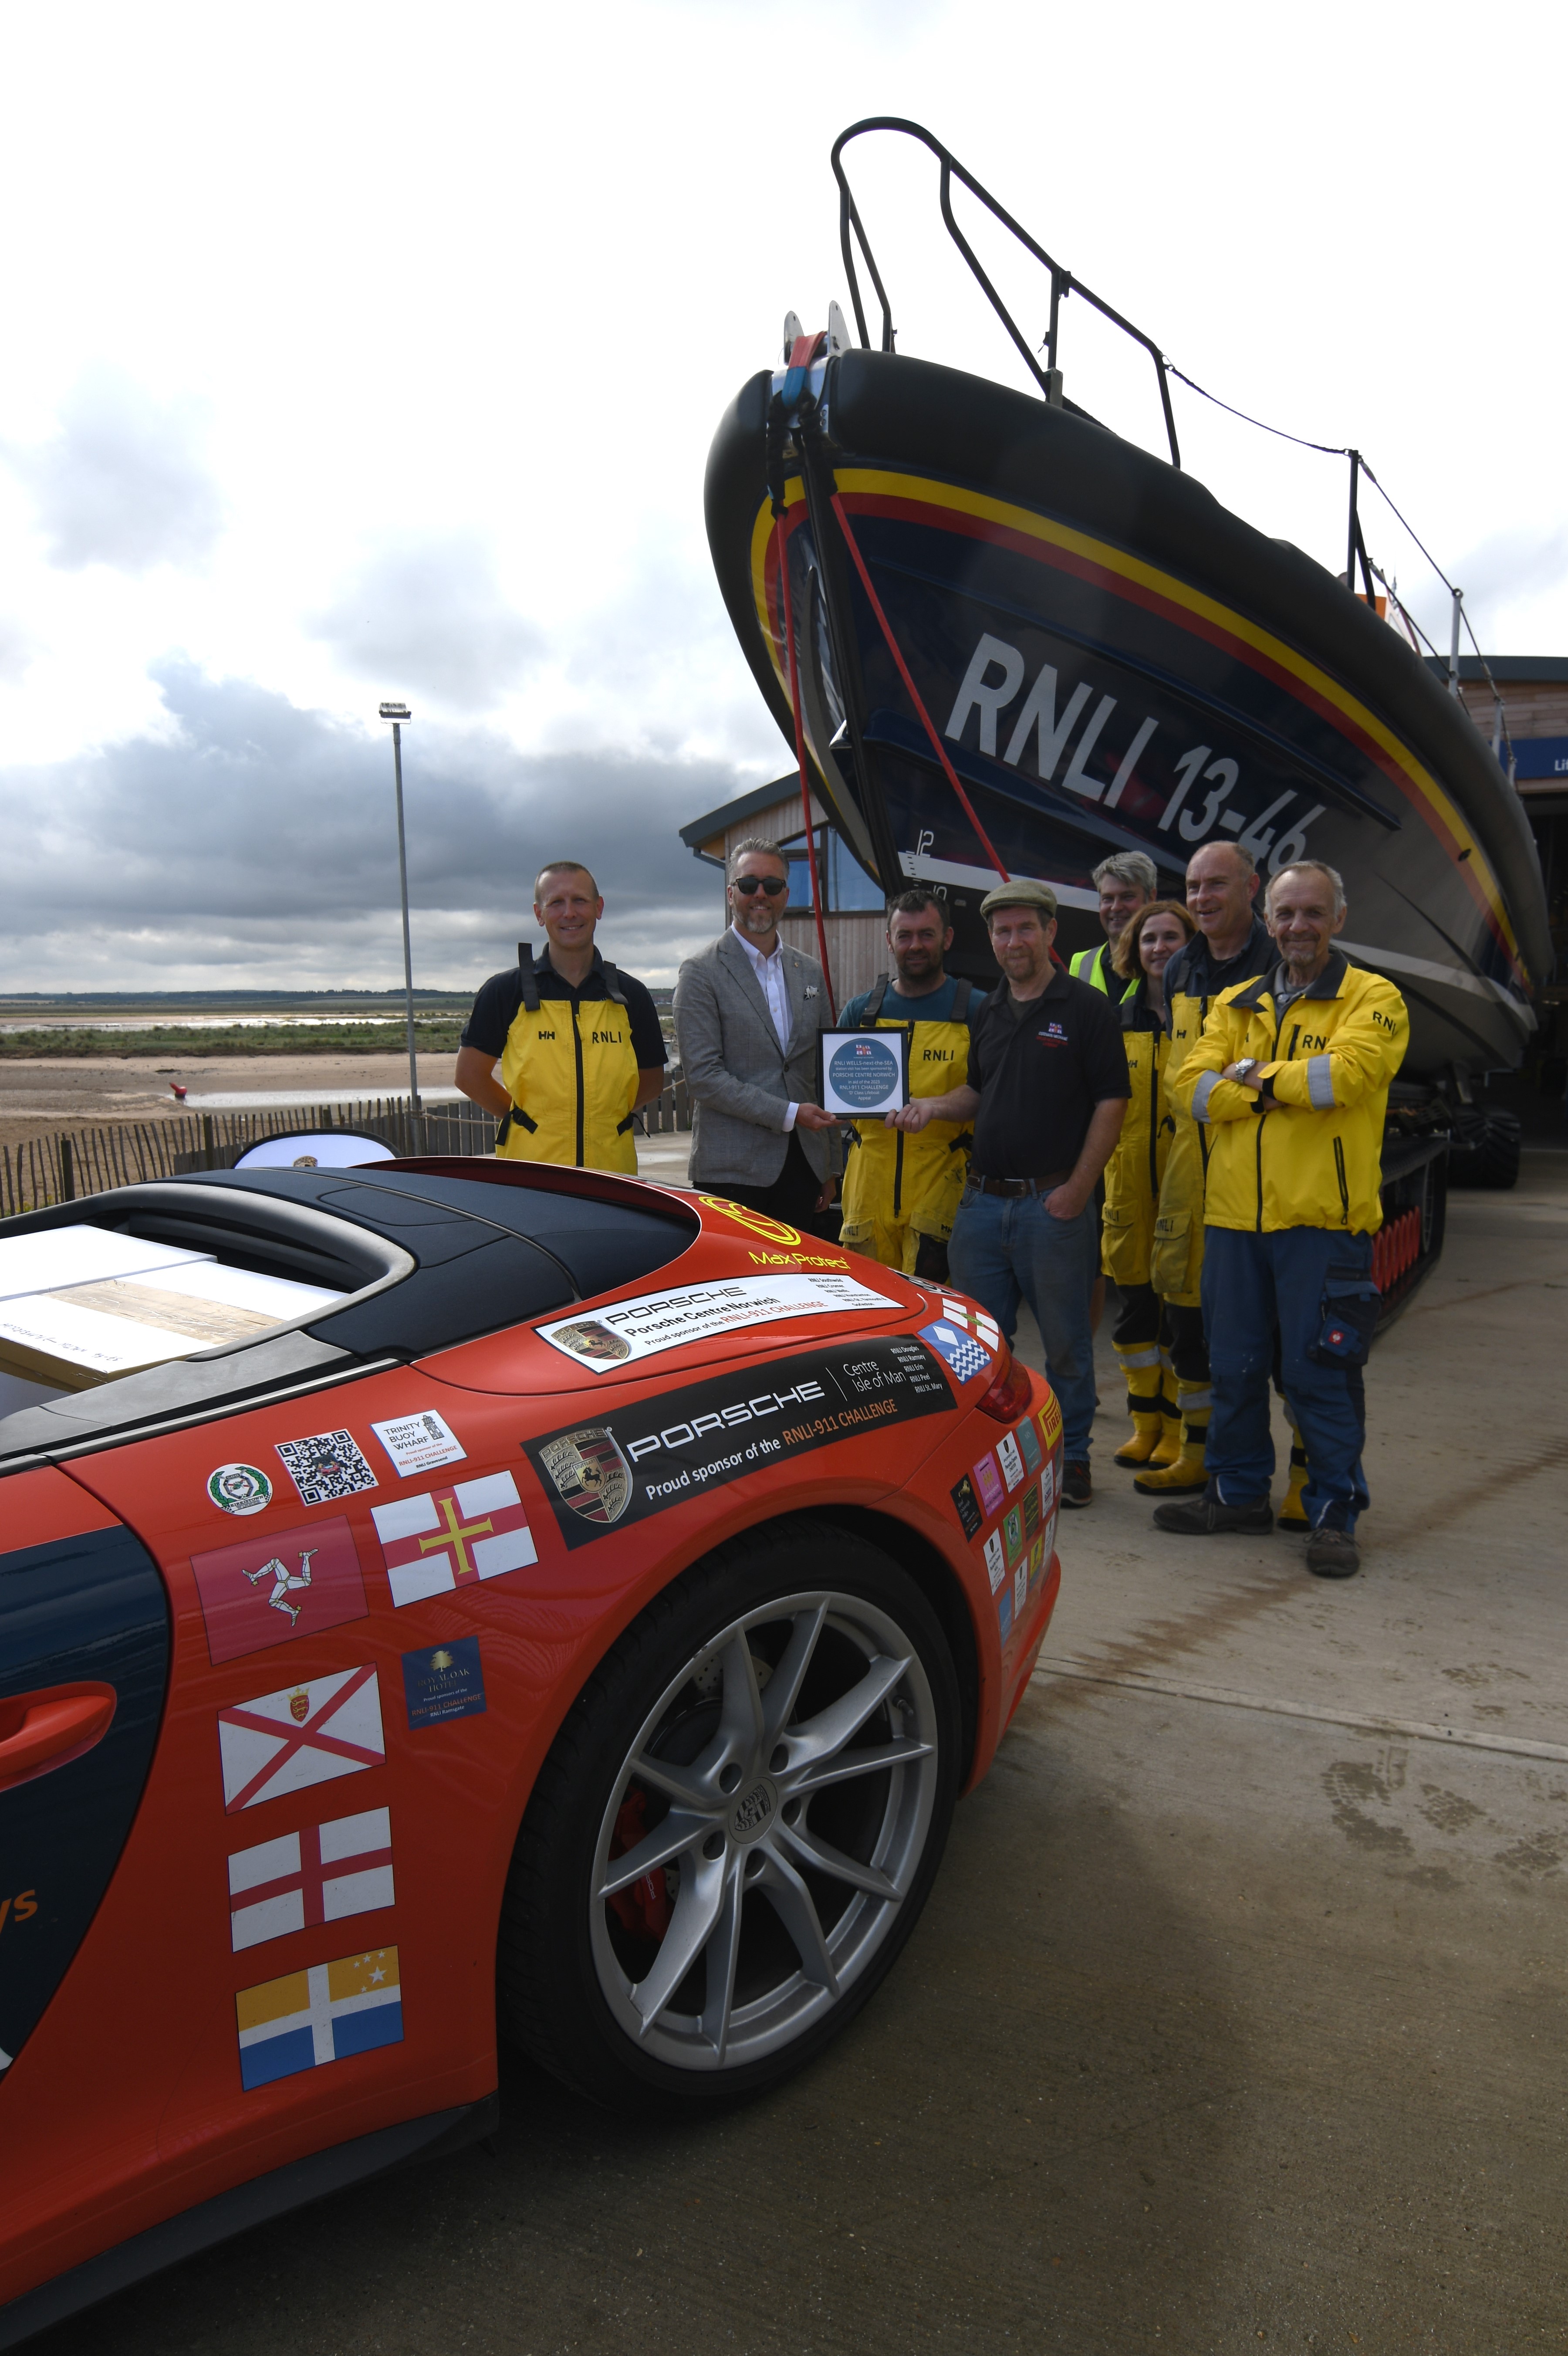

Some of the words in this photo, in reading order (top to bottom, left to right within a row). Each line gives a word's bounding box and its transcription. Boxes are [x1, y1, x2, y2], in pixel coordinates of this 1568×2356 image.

[944, 633, 1159, 809] RNLI
[1157, 745, 1327, 876] 13-46
[916, 829, 934, 858] 12
[592, 1031, 622, 1044] RNLI
[1302, 1034, 1330, 1051] RN
[923, 1049, 954, 1061] RNLI
[748, 1251, 796, 1265] Max
[605, 1287, 747, 1325] PORSCHE
[624, 1317, 687, 1337] Porsche
[683, 1307, 731, 1320] Centre
[729, 1296, 781, 1310] Norwich
[644, 1334, 672, 1345] Proud
[670, 1327, 702, 1337] sponsor
[720, 1308, 773, 1323] RNLI-911
[769, 1301, 829, 1313] CHALLENGE
[901, 1345, 919, 1353] Douglas
[843, 1361, 879, 1376] Centre
[852, 1376, 872, 1392] Isle
[872, 1372, 884, 1388] of
[882, 1371, 907, 1385] Man
[919, 1373, 931, 1381] Peel
[384, 1422, 420, 1435] TRINITY
[626, 1381, 825, 1463] PORSCHE
[389, 1431, 416, 1442] BUOY
[393, 1436, 429, 1450] WHARF
[542, 1429, 606, 1459] PORSCHE
[399, 1456, 425, 1466] RNLI-911
[425, 1445, 458, 1459] CHALLENGE
[645, 1470, 690, 1500] Proud
[692, 1452, 742, 1483] sponsor
[745, 1445, 760, 1460] of
[759, 1439, 781, 1454] the
[782, 1416, 839, 1445] RNLI-911
[838, 1398, 898, 1427] CHALLENGE
[426, 1456, 448, 1465] Gravesend
[574, 1459, 595, 1470] STUTTGART
[230, 1496, 264, 1507] KIRKISTOWN
[418, 1675, 449, 1687] ROYAL
[450, 1669, 470, 1679] OAK
[429, 1680, 457, 1693] HOTEL
[411, 1704, 442, 1716] RNLI-911
[443, 1693, 482, 1708] CHALLENGE
[442, 1705, 465, 1715] Ramsgate
